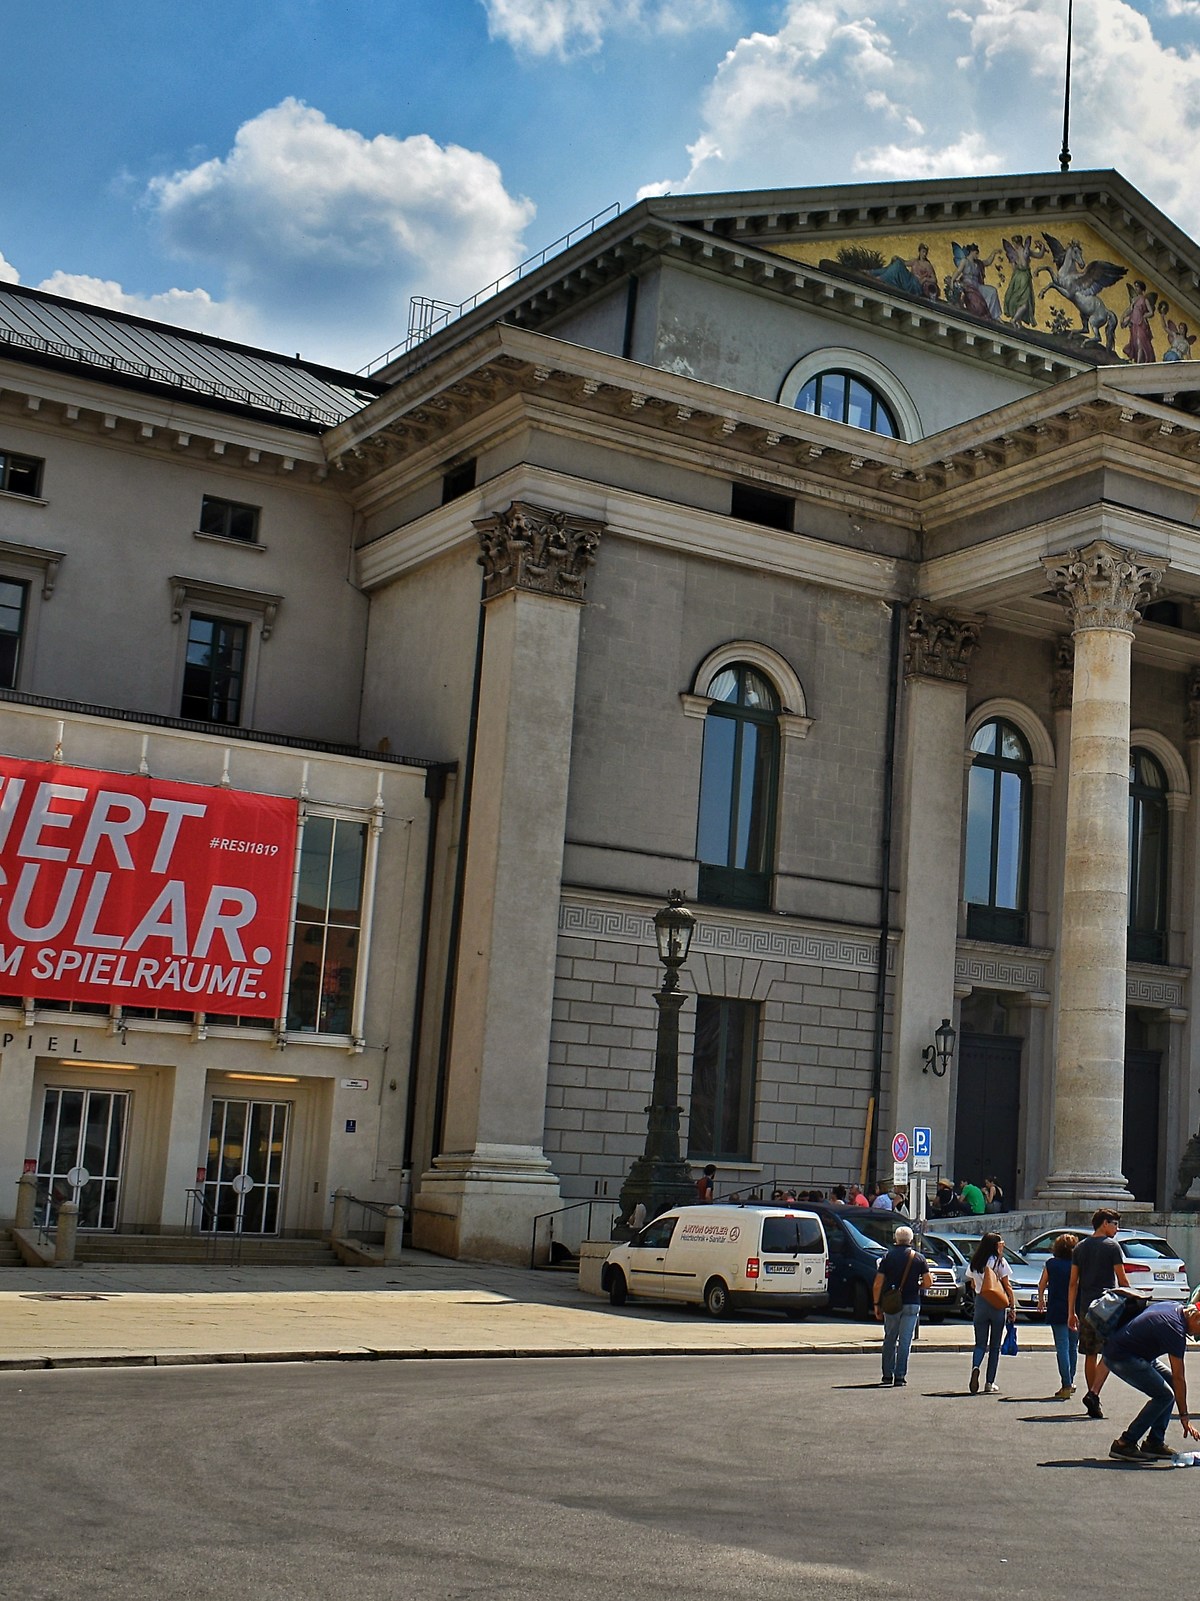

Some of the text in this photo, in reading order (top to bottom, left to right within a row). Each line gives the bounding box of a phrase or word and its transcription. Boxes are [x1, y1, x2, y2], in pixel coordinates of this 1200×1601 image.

[0, 776, 207, 874] IERT
[209, 837, 279, 857] #RESI1819
[0, 862, 272, 965] ULAR.
[31, 947, 267, 1000] SPIELRÄUME.
[916, 1131, 926, 1153] P
